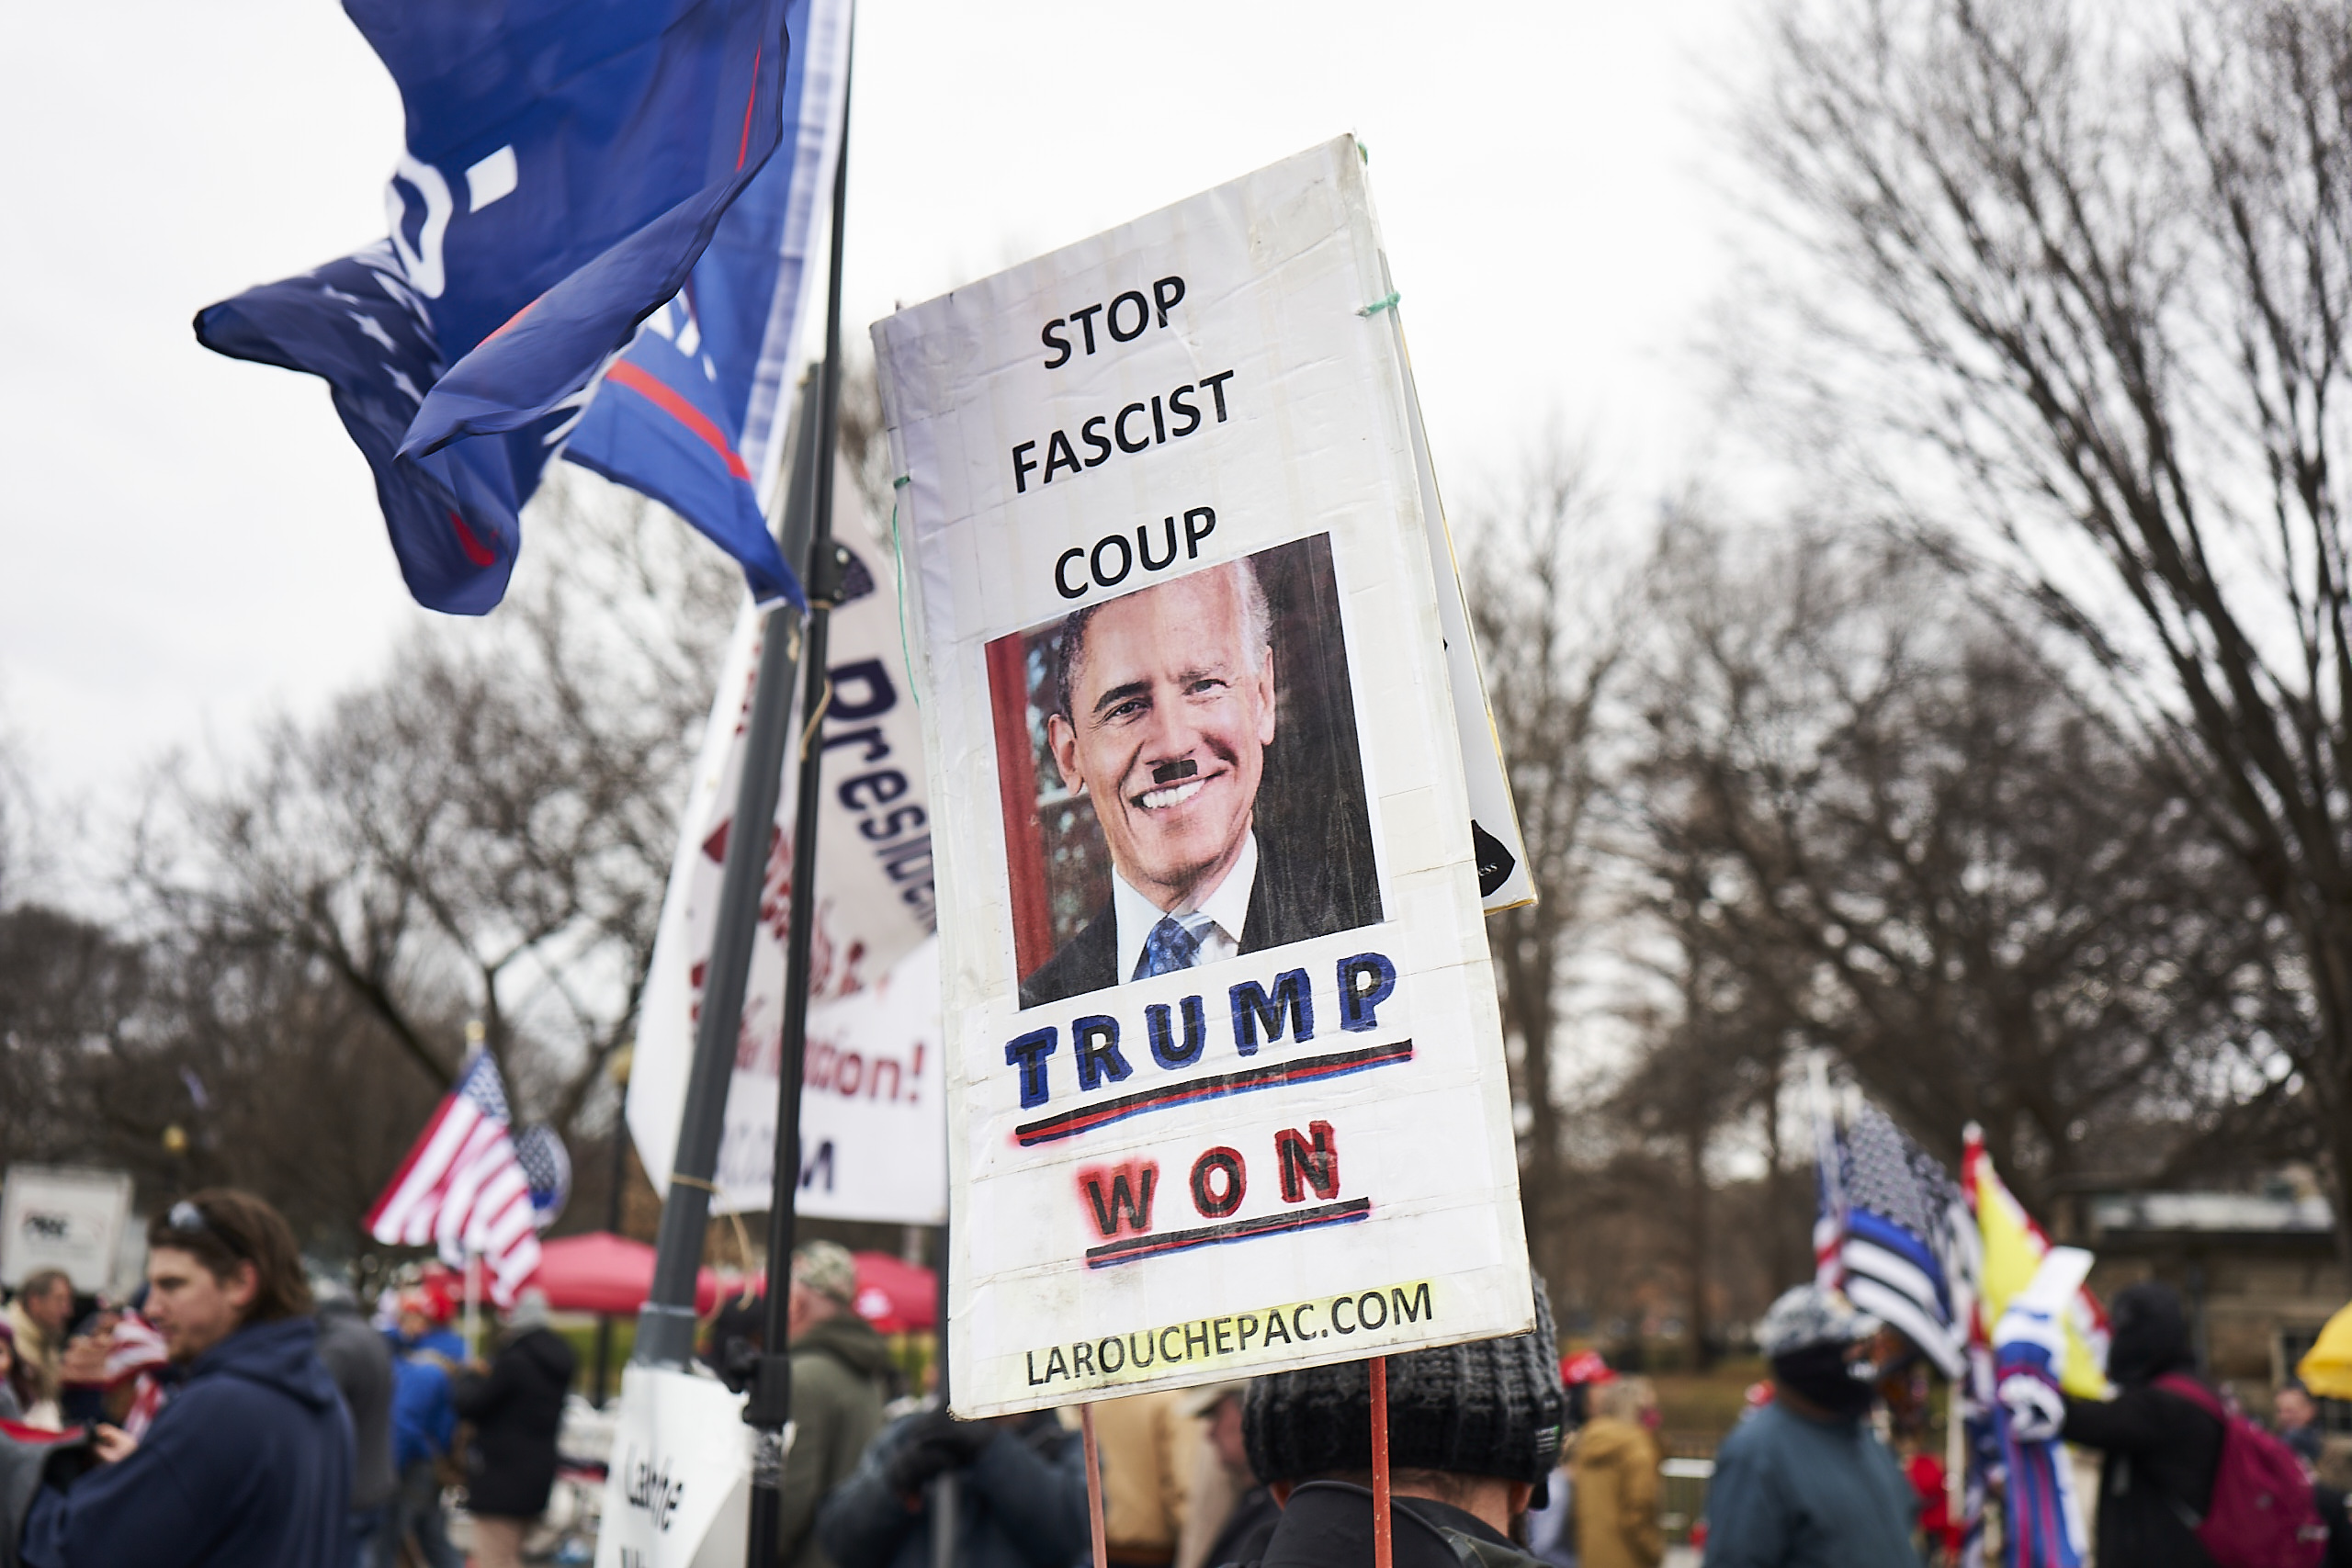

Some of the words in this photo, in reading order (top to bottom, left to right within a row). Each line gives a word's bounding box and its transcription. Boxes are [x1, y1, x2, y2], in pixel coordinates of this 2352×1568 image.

[1041, 276, 1186, 369] STOP
[1012, 369, 1234, 493] FASCIST
[1055, 505, 1216, 599] COUP
[1006, 952, 1397, 1110] TRUMP
[1079, 1121, 1340, 1237] WON
[1025, 1282, 1433, 1386] LAROUCHEPAC.COM
